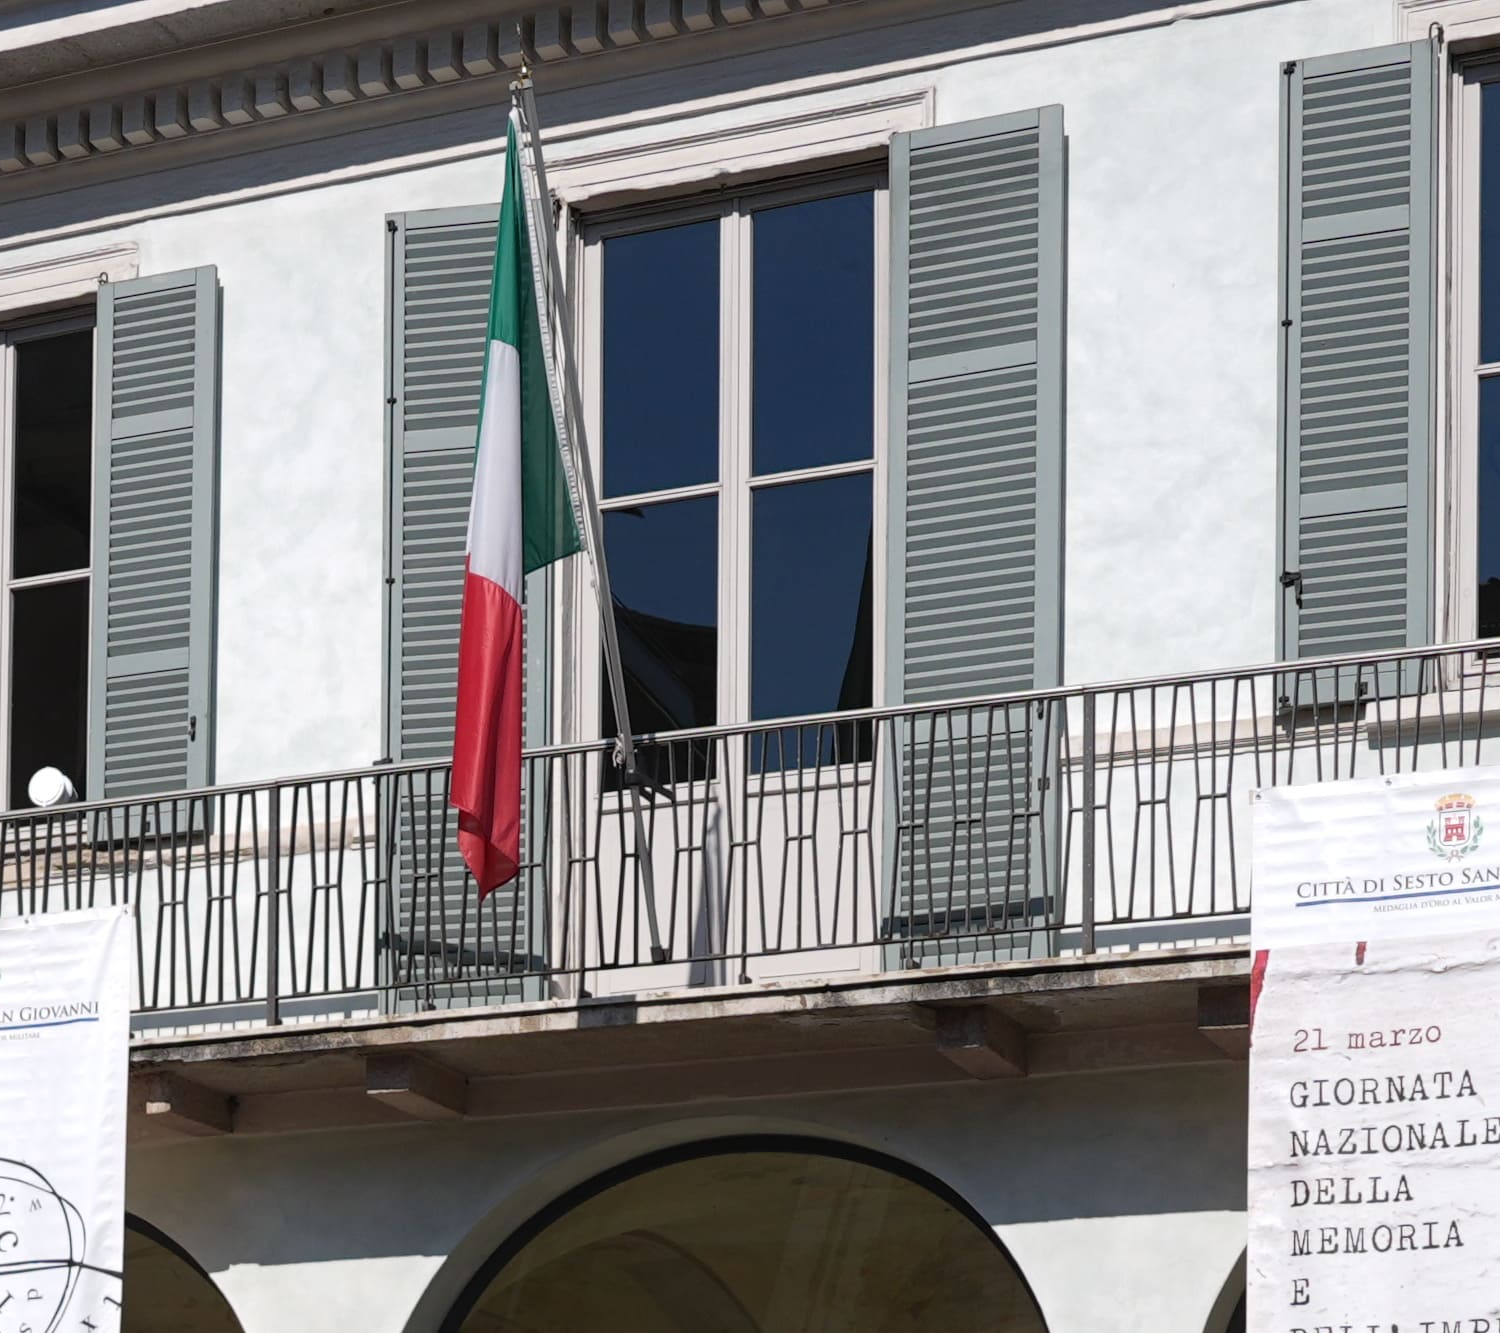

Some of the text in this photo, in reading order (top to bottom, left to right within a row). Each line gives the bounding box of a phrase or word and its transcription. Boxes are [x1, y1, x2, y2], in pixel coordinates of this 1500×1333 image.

[1296, 877, 1356, 898] CITTÀ
[1363, 878, 1384, 894] DI
[1393, 871, 1454, 891] SESTO
[1461, 867, 1500, 885] SAN
[25, 1001, 99, 1021] GIOVANNI
[1293, 1026, 1441, 1052] 21 marzo
[1290, 1069, 1478, 1108] GIORNATA
[1290, 1174, 1414, 1207] DELLA
[1290, 1220, 1464, 1256] MEMORIA
[1290, 1278, 1310, 1305] E
